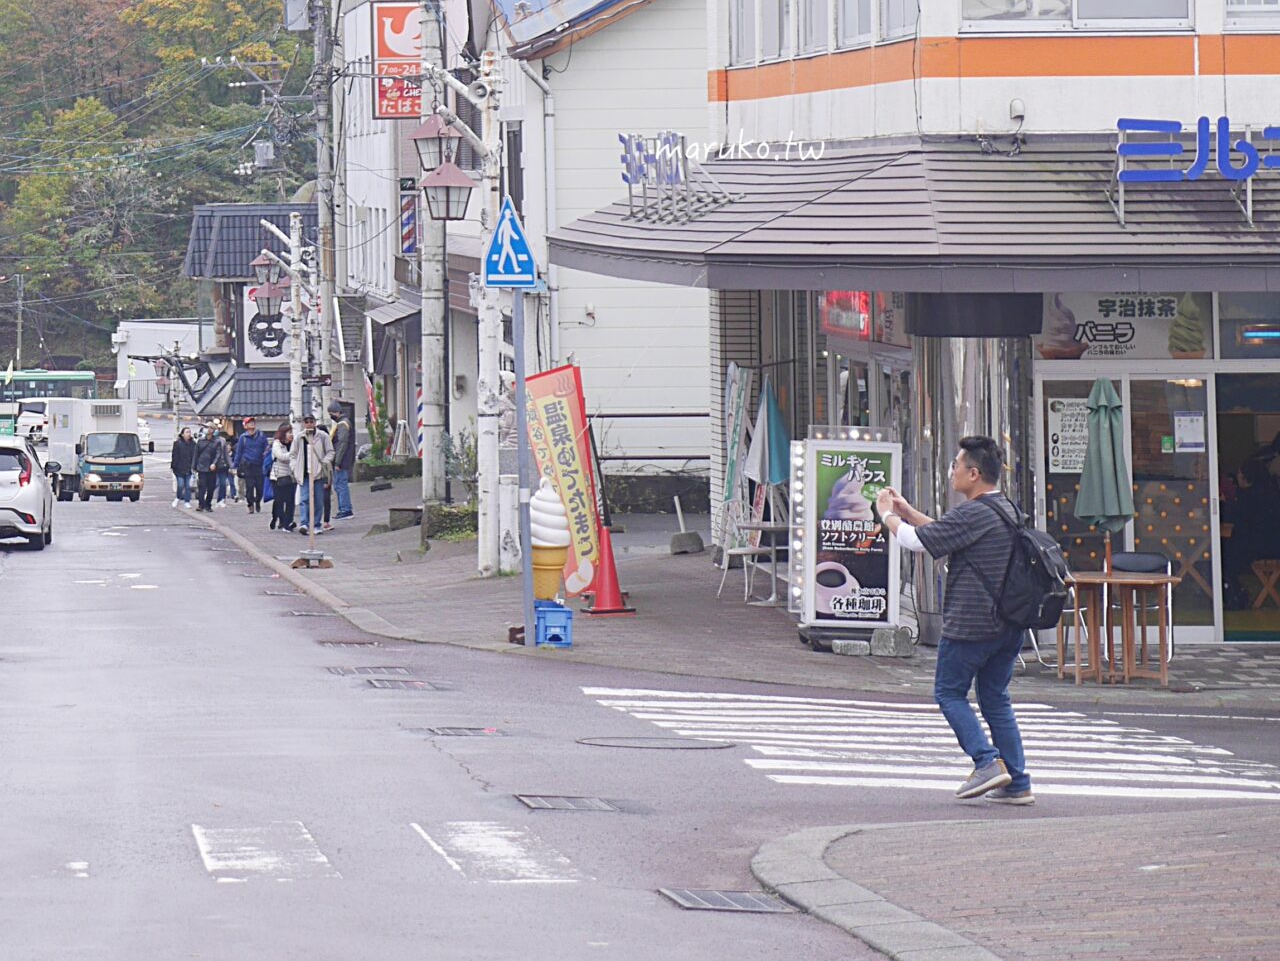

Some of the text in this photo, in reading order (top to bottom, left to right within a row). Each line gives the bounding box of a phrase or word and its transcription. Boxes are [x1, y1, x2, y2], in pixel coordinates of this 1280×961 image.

[1098, 298, 1177, 318] 宇治抹茶
[1074, 321, 1135, 343] バニラ
[821, 454, 881, 467] ミルキィー
[848, 469, 885, 482] ハウス
[821, 531, 885, 543] ソフトクリーム
[832, 596, 884, 611] 各種珈琲
